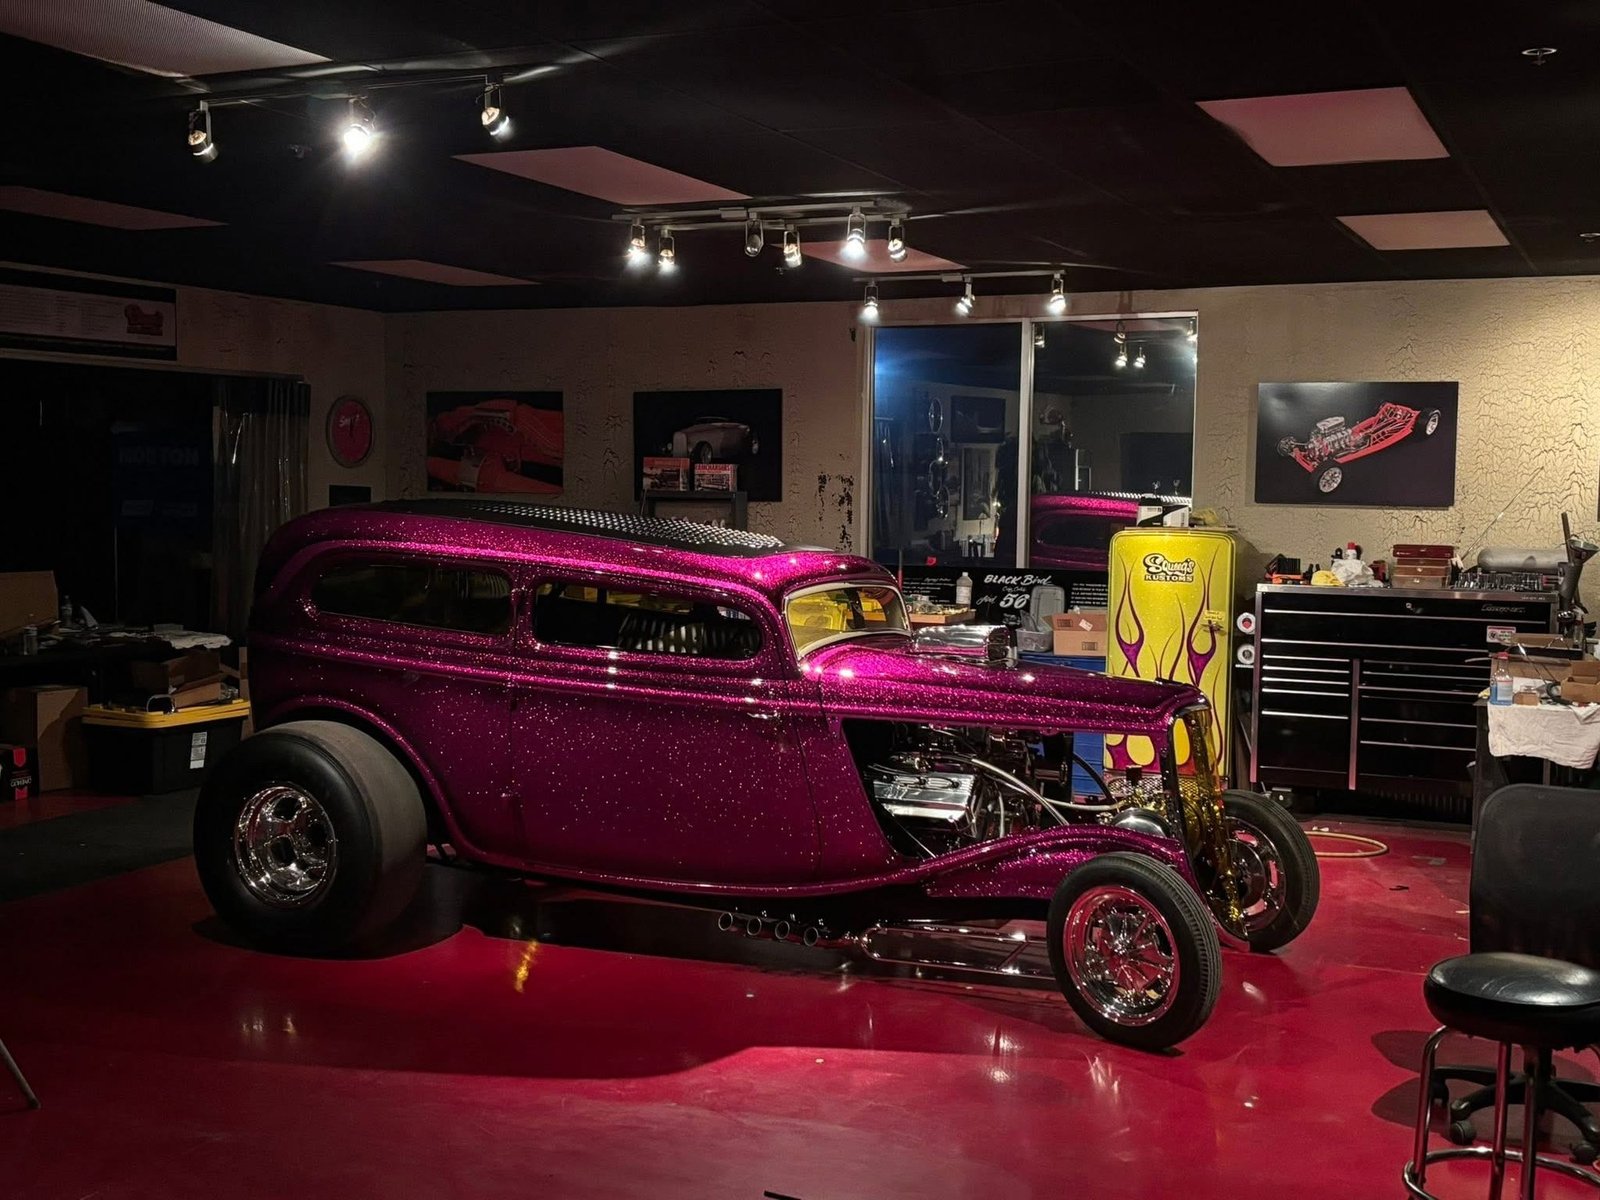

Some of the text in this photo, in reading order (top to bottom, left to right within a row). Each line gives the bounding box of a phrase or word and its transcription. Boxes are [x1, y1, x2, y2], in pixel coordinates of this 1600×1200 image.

[984, 574, 1053, 586] BLACK Bird
[1144, 574, 1194, 583] KUSTOMS
[999, 593, 1031, 609] 56
